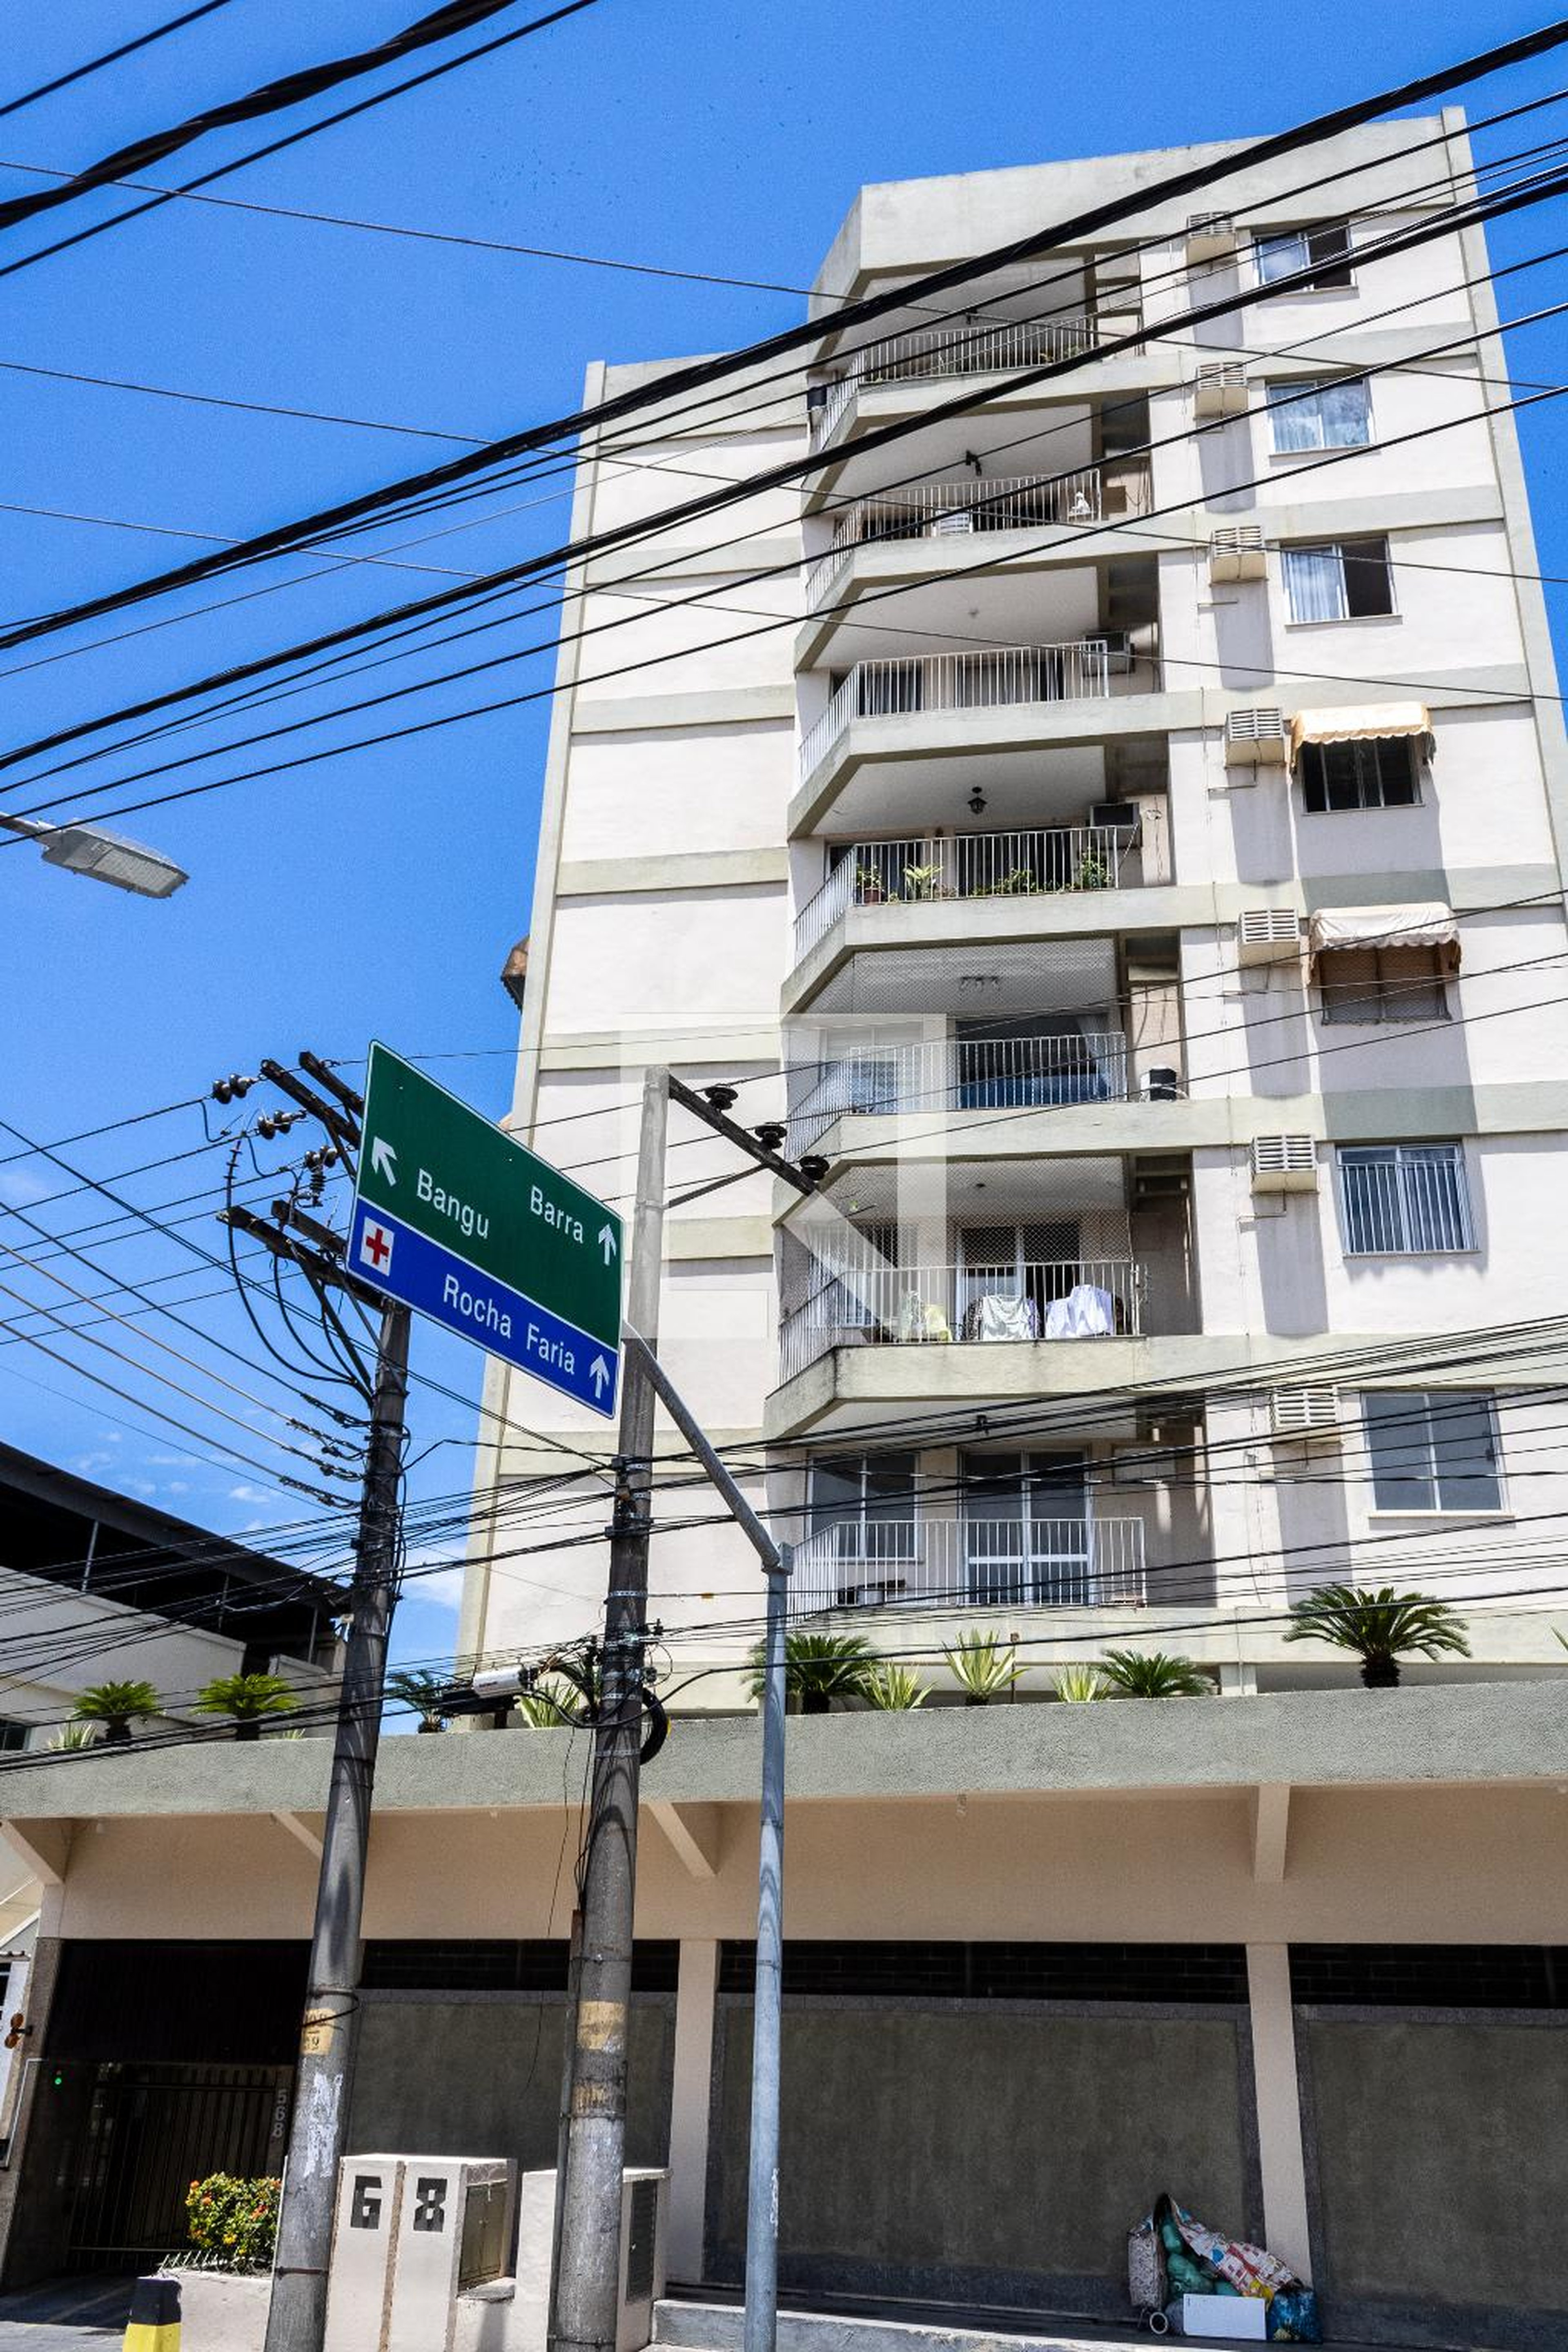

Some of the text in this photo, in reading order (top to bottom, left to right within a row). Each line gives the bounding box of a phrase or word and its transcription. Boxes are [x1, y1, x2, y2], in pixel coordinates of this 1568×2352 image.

[416, 1168, 489, 1239] Bangu
[530, 1185, 584, 1244] Barra
[443, 1274, 575, 1376] Rocha Faria
[273, 2088, 287, 2138] 568
